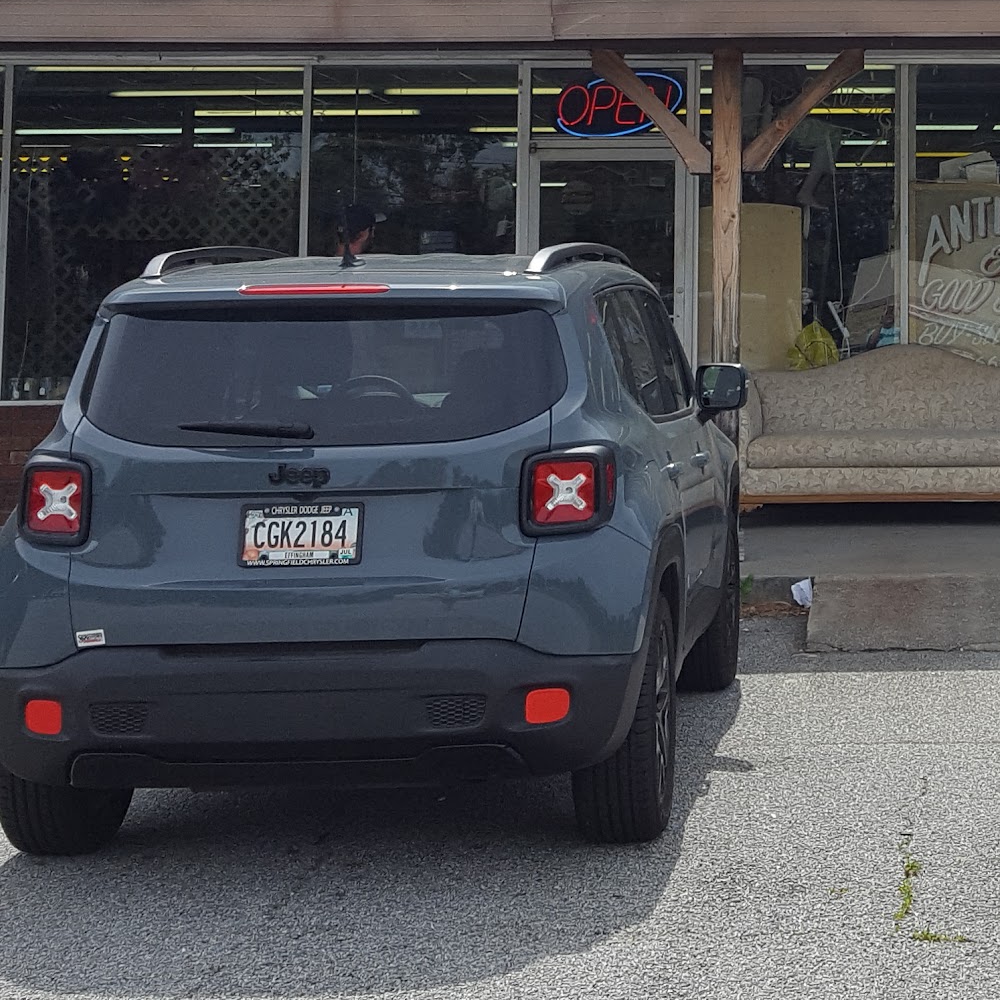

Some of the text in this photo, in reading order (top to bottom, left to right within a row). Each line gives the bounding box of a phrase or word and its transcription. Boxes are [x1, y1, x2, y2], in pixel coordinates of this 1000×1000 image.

[921, 278, 997, 314] GOOD
[268, 463, 331, 489] Jeep
[271, 505, 298, 515] CHRYSLER
[299, 505, 319, 514] DODGE
[320, 505, 333, 514] JEEP
[253, 520, 347, 549] CGK2184
